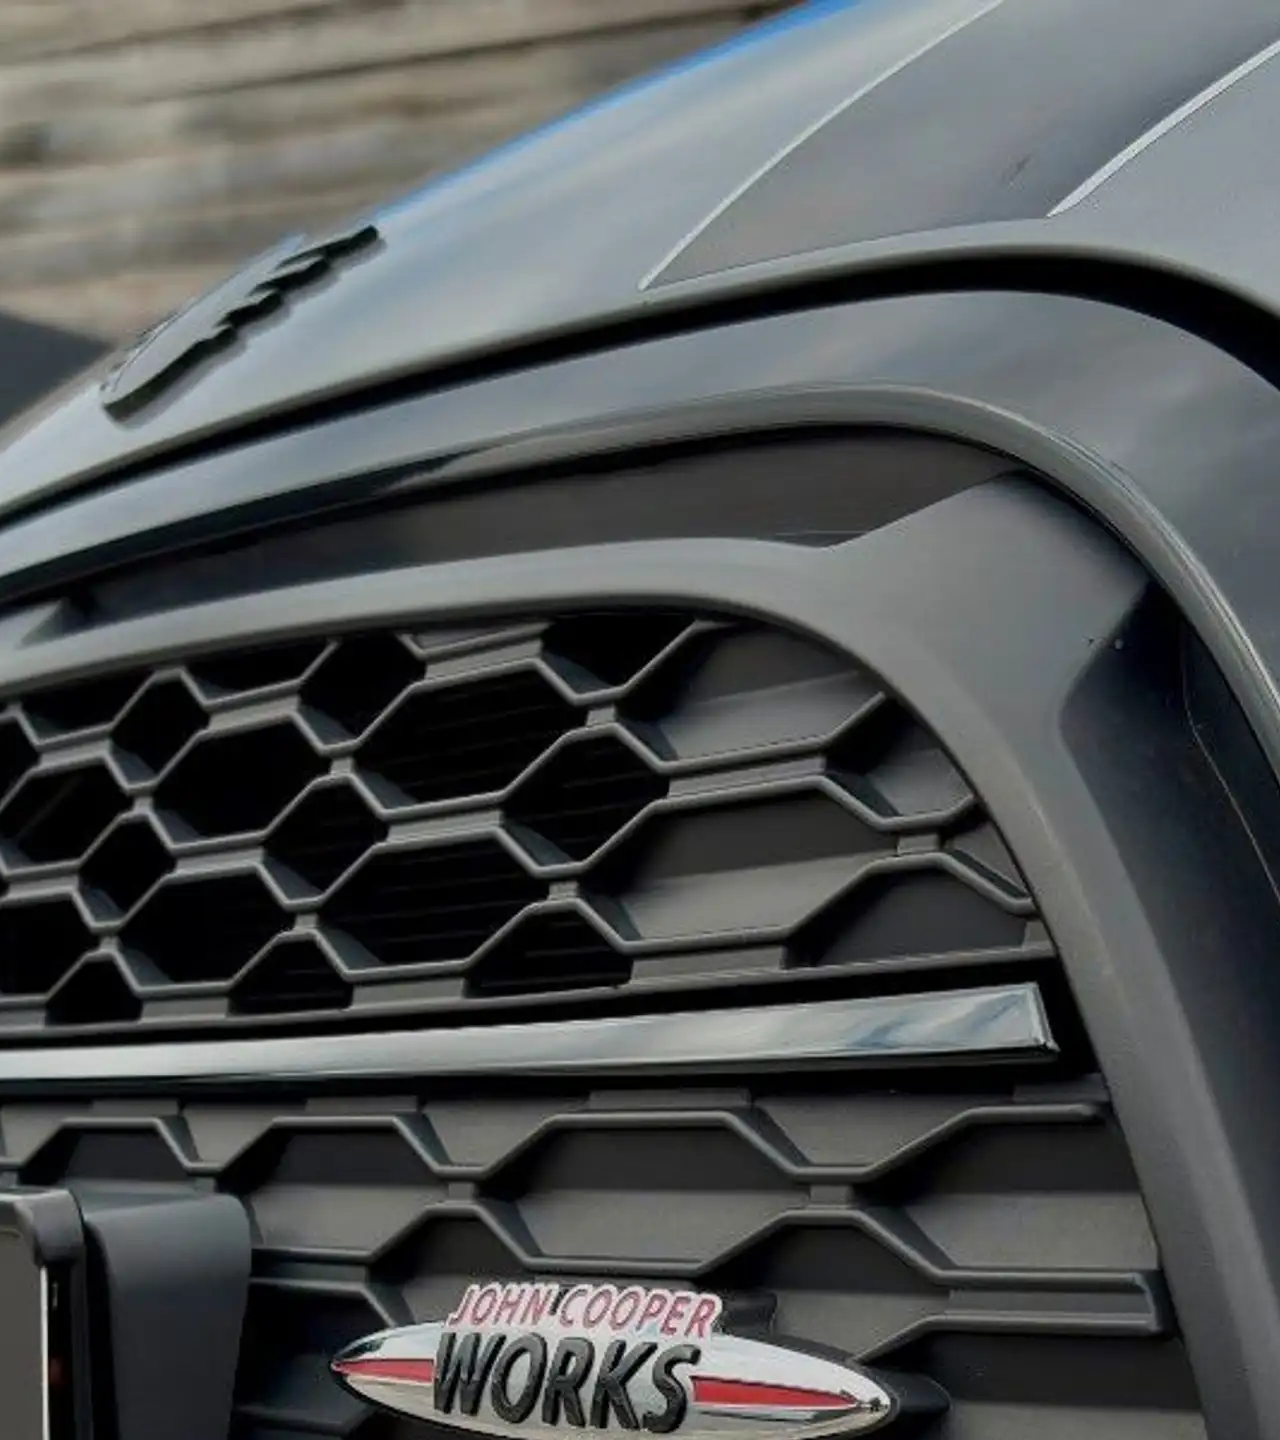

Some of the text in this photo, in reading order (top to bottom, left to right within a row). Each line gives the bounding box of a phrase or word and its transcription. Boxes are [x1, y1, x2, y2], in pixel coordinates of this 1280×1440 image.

[447, 1282, 723, 1338] JOHN COOPER
[432, 1331, 702, 1434] WORKS
